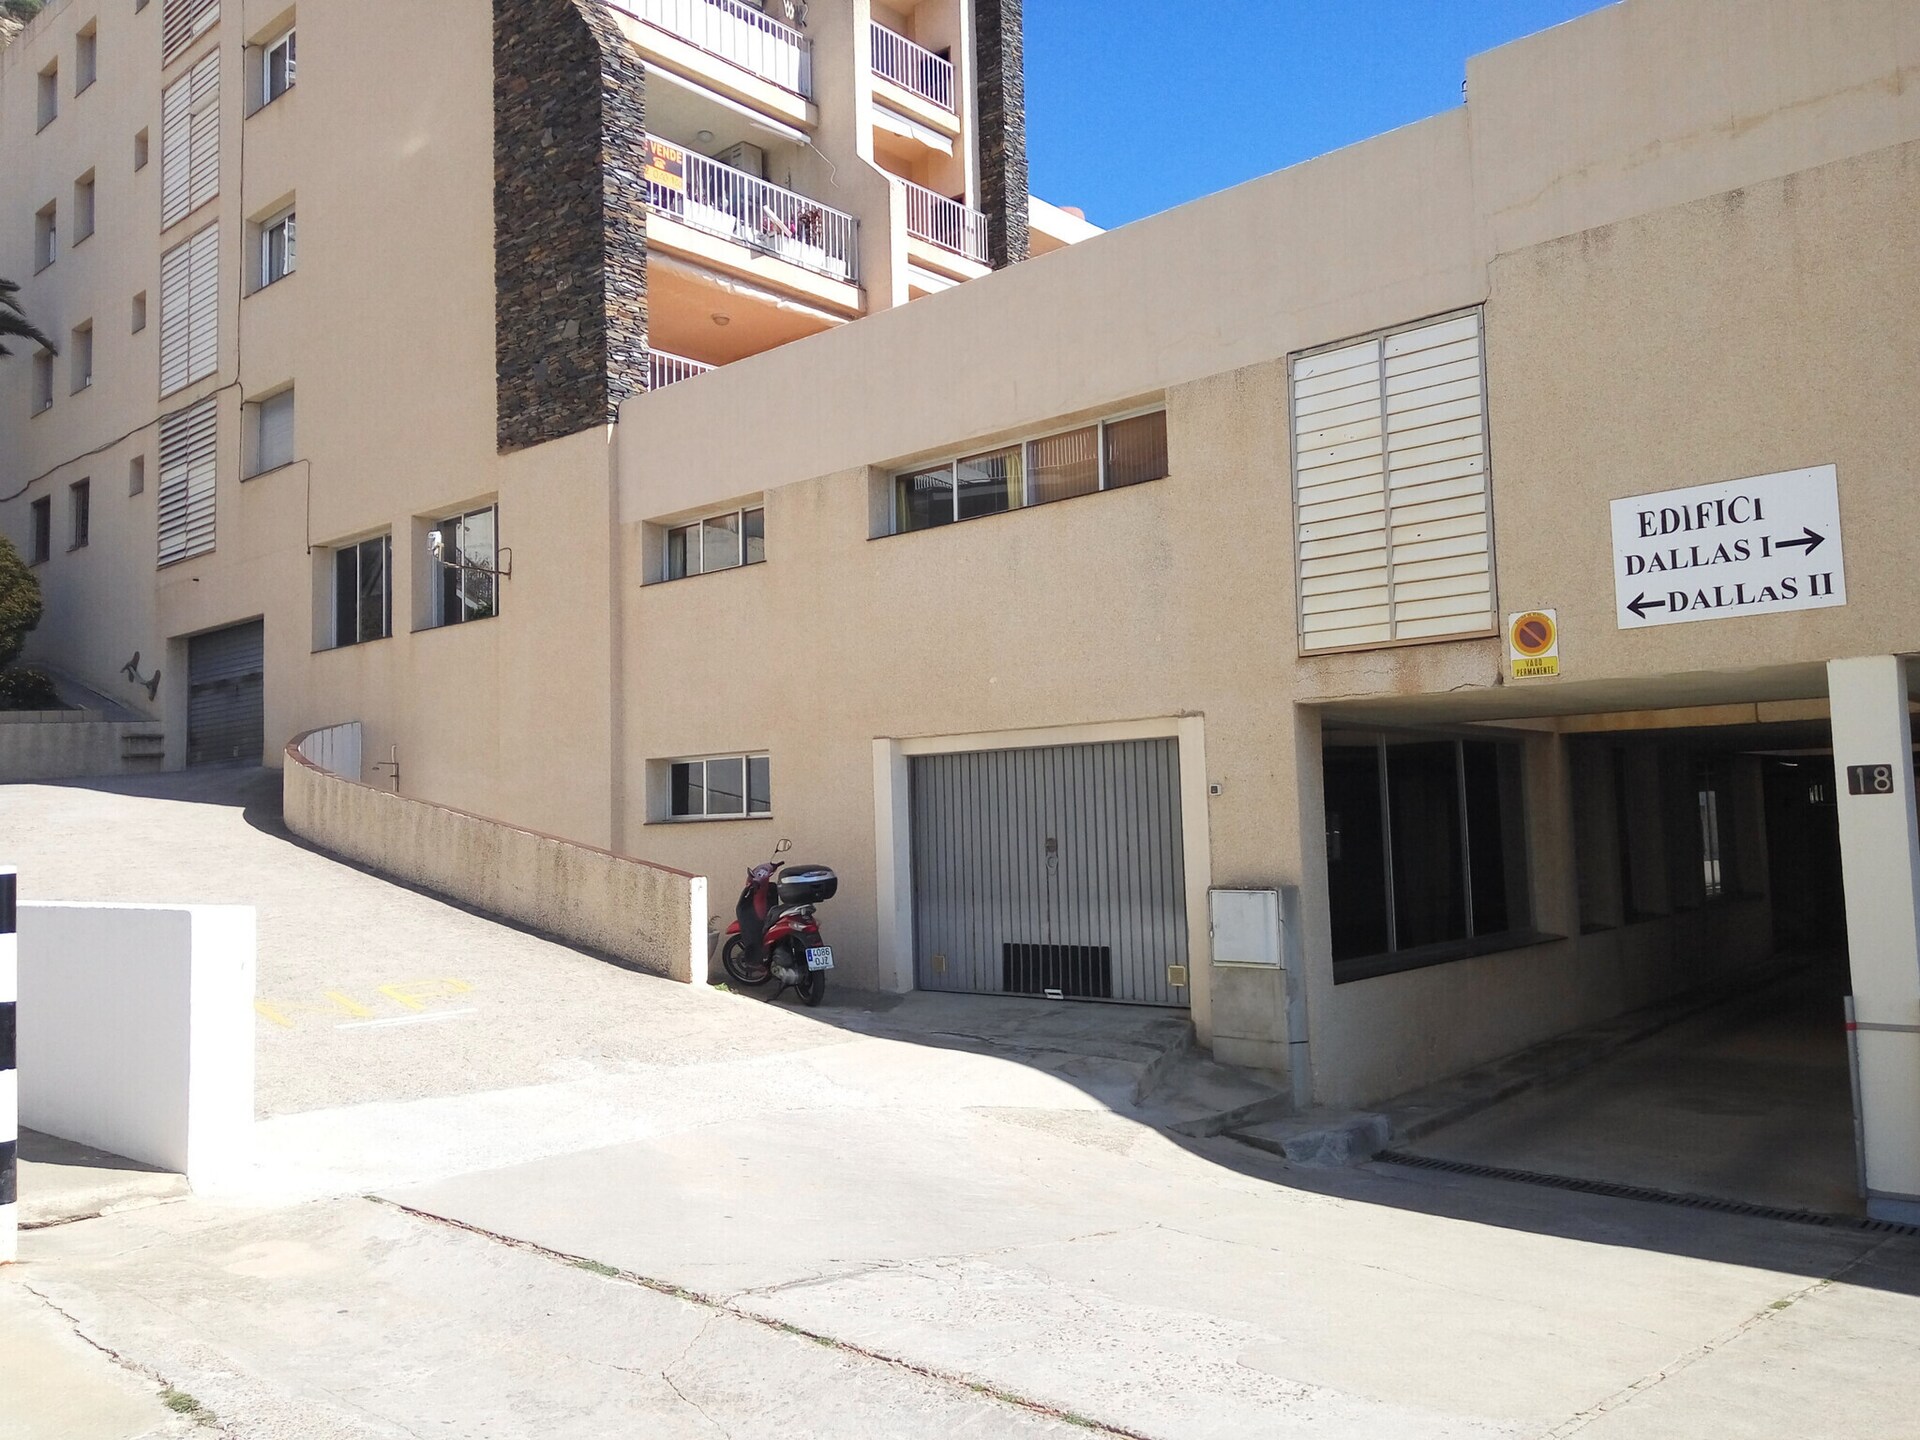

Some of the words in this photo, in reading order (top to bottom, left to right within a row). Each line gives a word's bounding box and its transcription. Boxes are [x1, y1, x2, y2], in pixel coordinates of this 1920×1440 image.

[650, 140, 683, 164] VENDE
[1637, 495, 1765, 538] EDIFICI
[1624, 538, 1751, 576] DALLAS
[1760, 535, 1773, 559] I
[1667, 576, 1799, 613] DALLAS
[1808, 572, 1834, 597] II
[1516, 665, 1554, 677] PERMANENTE
[1525, 657, 1543, 667] VADO
[1856, 766, 1891, 794] 18
